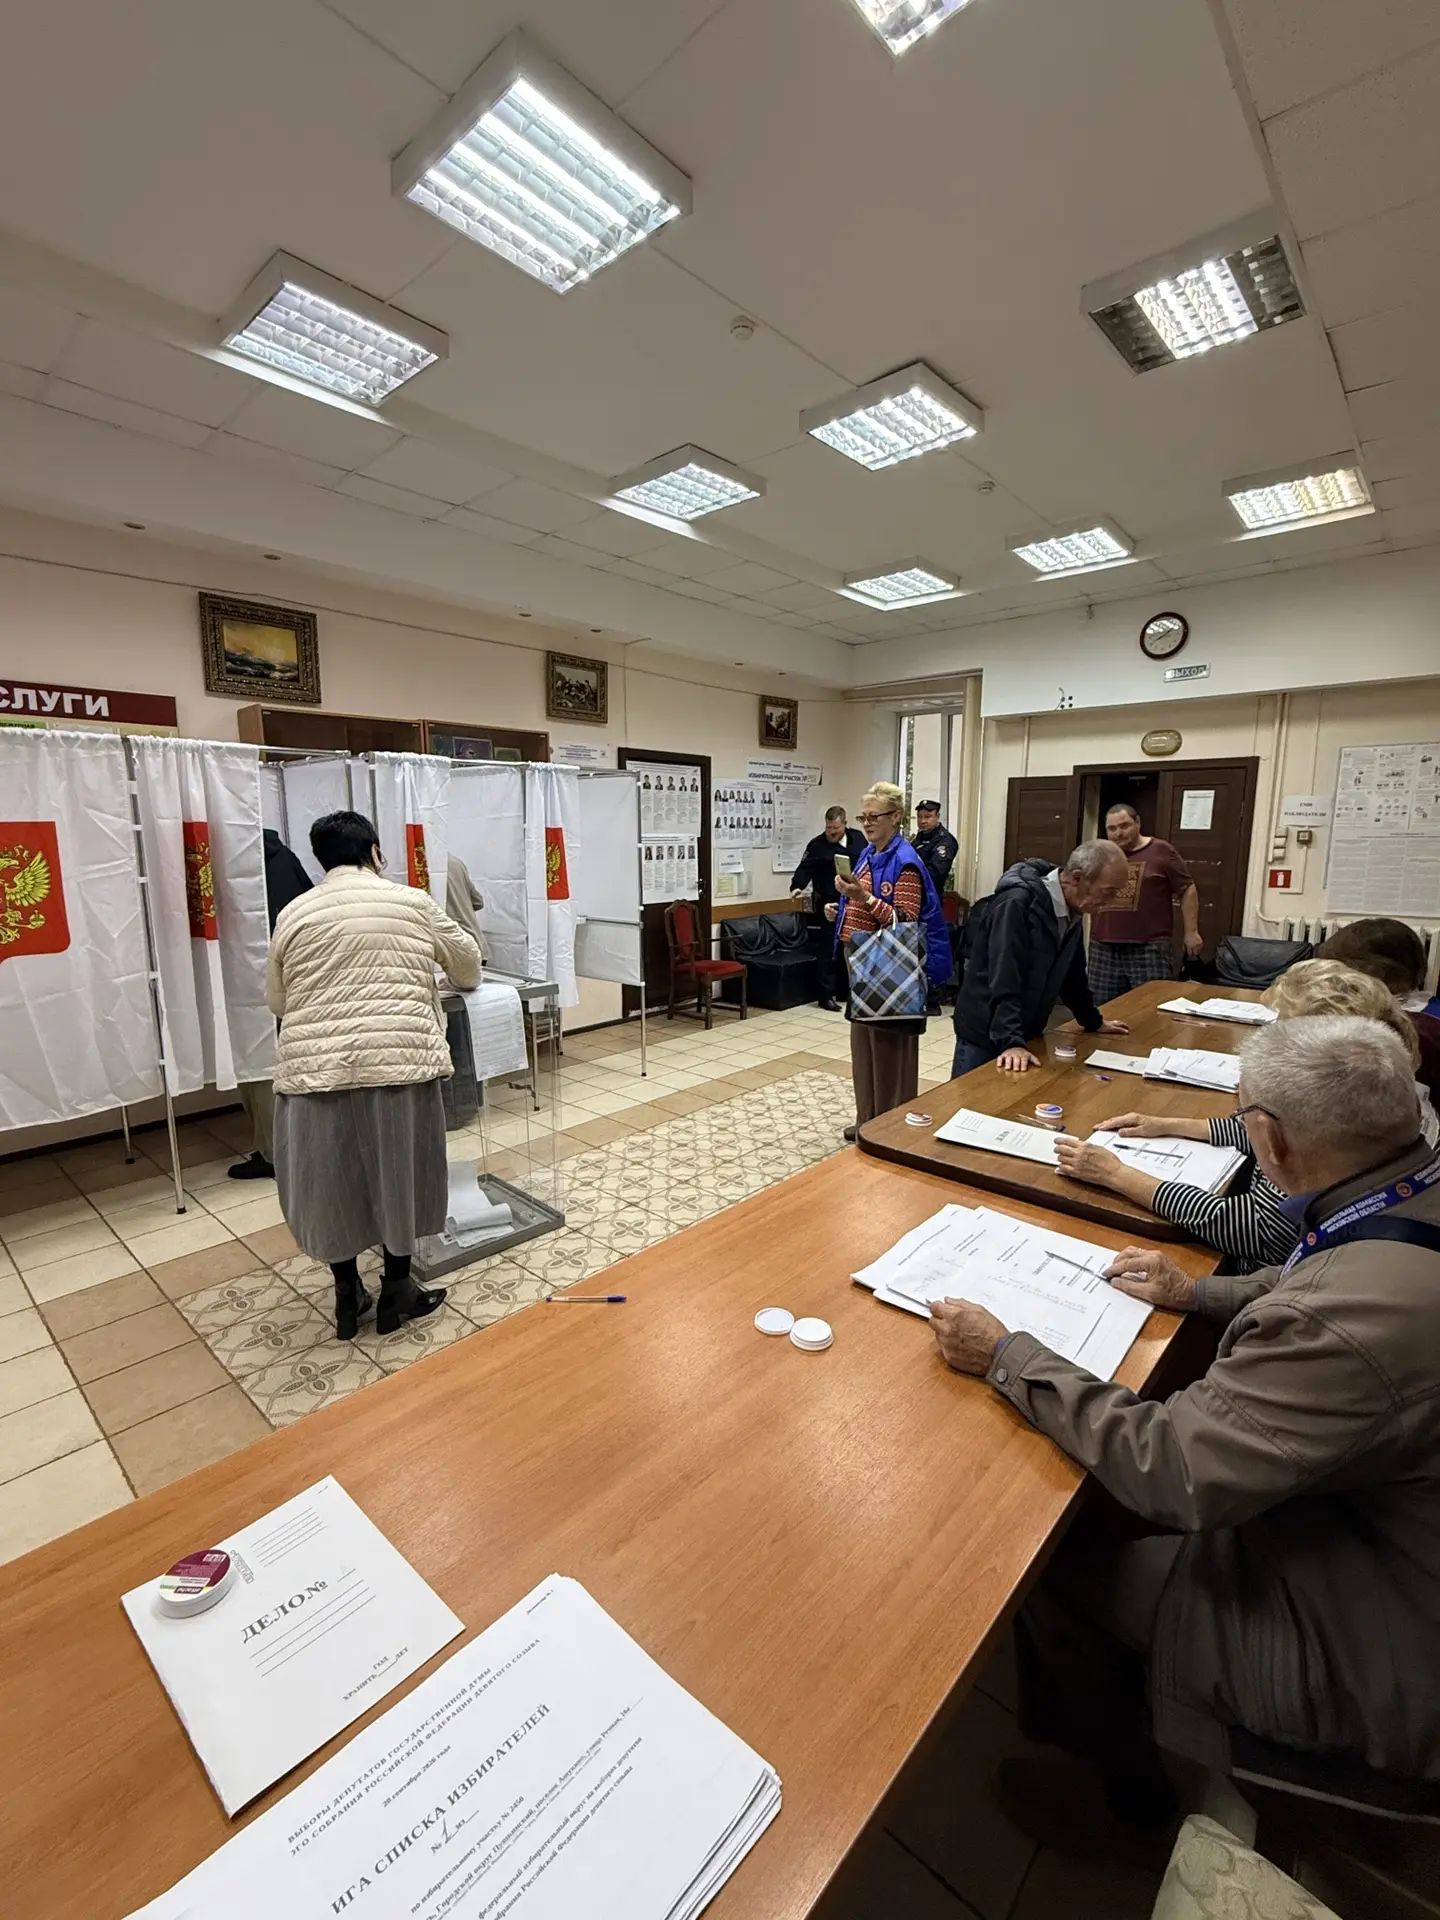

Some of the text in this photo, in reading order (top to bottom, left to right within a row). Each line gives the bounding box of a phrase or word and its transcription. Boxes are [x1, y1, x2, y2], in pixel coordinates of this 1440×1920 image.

[288, 1668, 491, 1843] ВЫБОРЫ ДЕПУТАТОВ ГОСУДАРСТВЕННОЙ ДУМЫ
[312, 1792, 363, 1838] СОБРАНИЯ
[365, 1739, 424, 1793] РОССИЙСКОЙ
[425, 1697, 472, 1739] ФЕДЕРАЦИИ
[474, 1663, 511, 1698] ДЕВЯТОГО
[512, 1640, 540, 1663] СОЗЫВА
[343, 1674, 377, 1700] ХРАНИТЬ
[375, 1807, 446, 1874] СПИСКА
[447, 1704, 550, 1806] ИЗБИРАТЕЛЕЙ
[476, 1820, 501, 1849] участку
